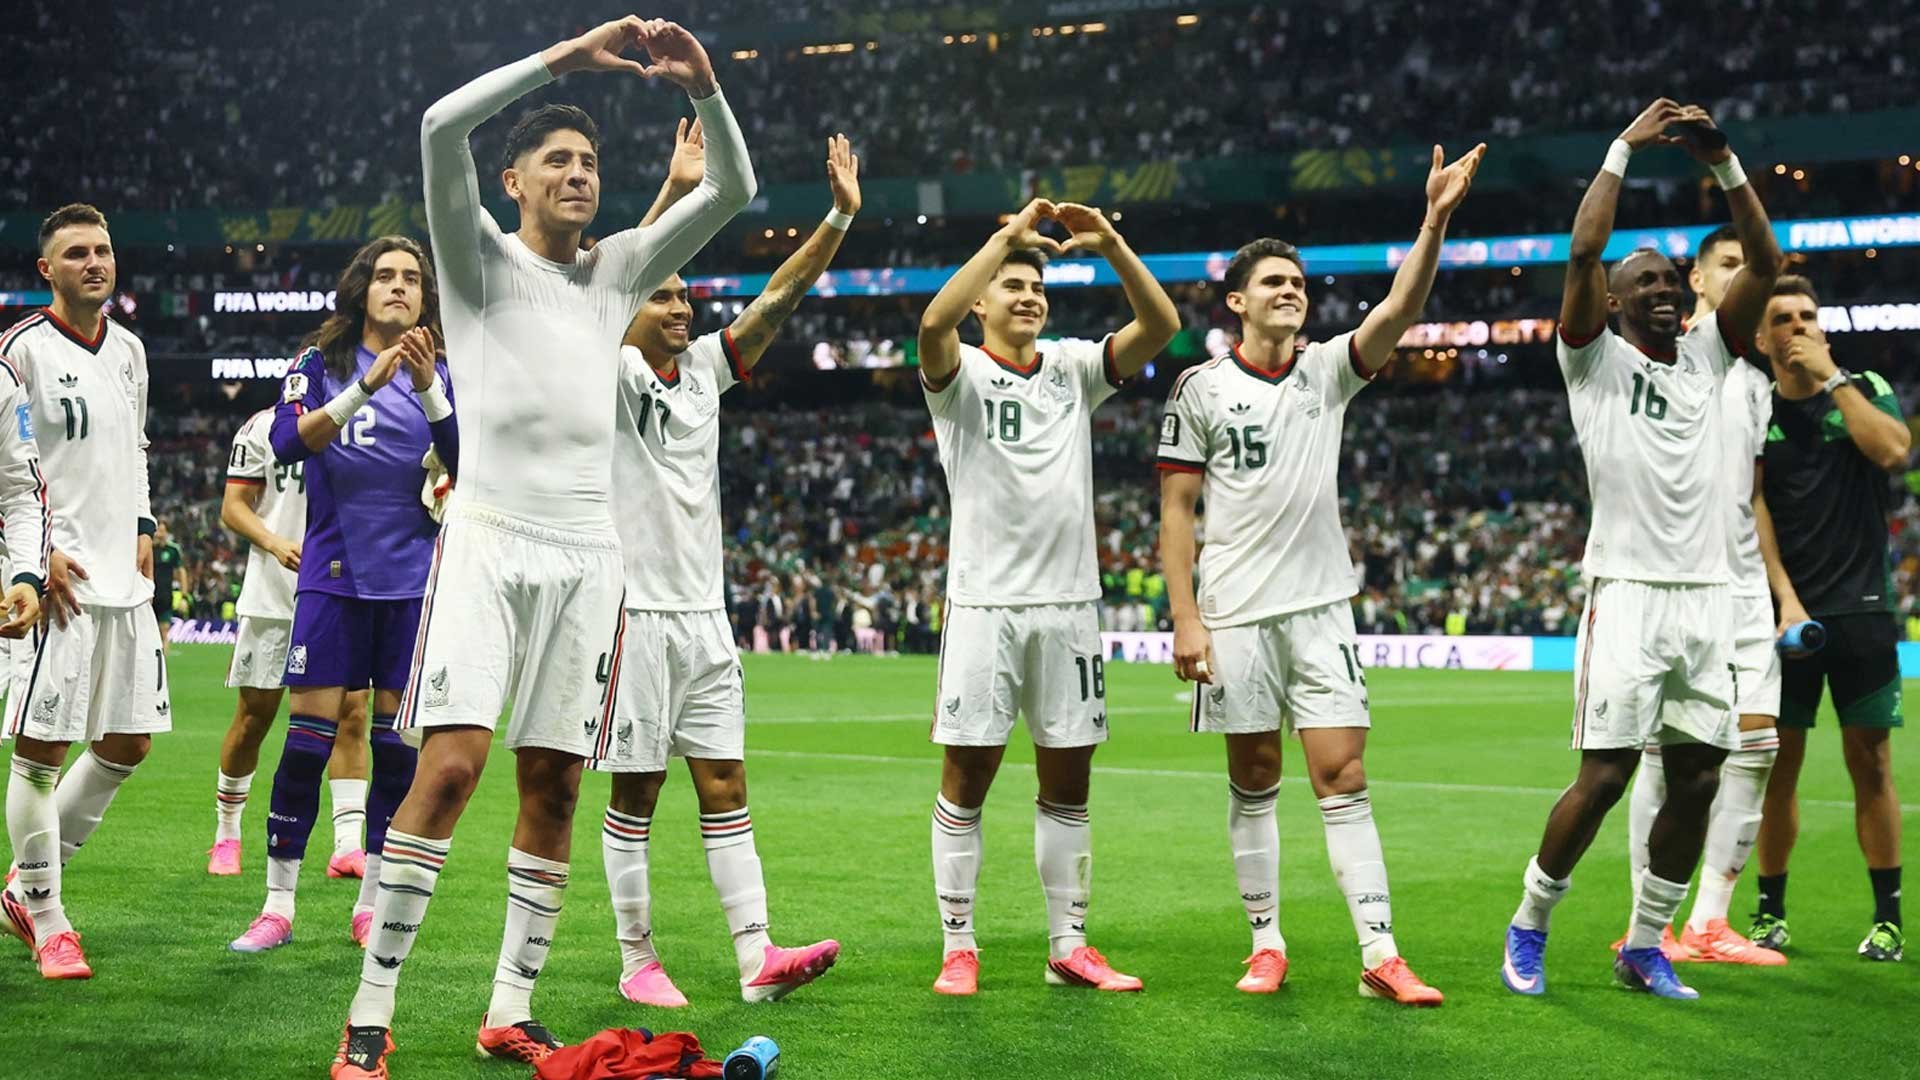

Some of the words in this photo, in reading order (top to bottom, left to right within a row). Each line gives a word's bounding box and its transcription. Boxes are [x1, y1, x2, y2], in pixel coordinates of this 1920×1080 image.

[1789, 221, 1850, 248] FIFA
[1850, 215, 1920, 246] WOR
[214, 291, 256, 312] FIFA
[256, 291, 325, 312] WORLD
[1850, 303, 1920, 332] WOR
[211, 358, 255, 379] FIFA
[1630, 372, 1668, 421] 16
[59, 396, 88, 440] 11
[340, 404, 377, 446] 12
[637, 393, 671, 445] 17
[984, 399, 1021, 442] 18
[1226, 425, 1267, 470] 15
[167, 616, 237, 645] Michelo
[1374, 643, 1464, 669] RICA
[1075, 654, 1105, 702] 18
